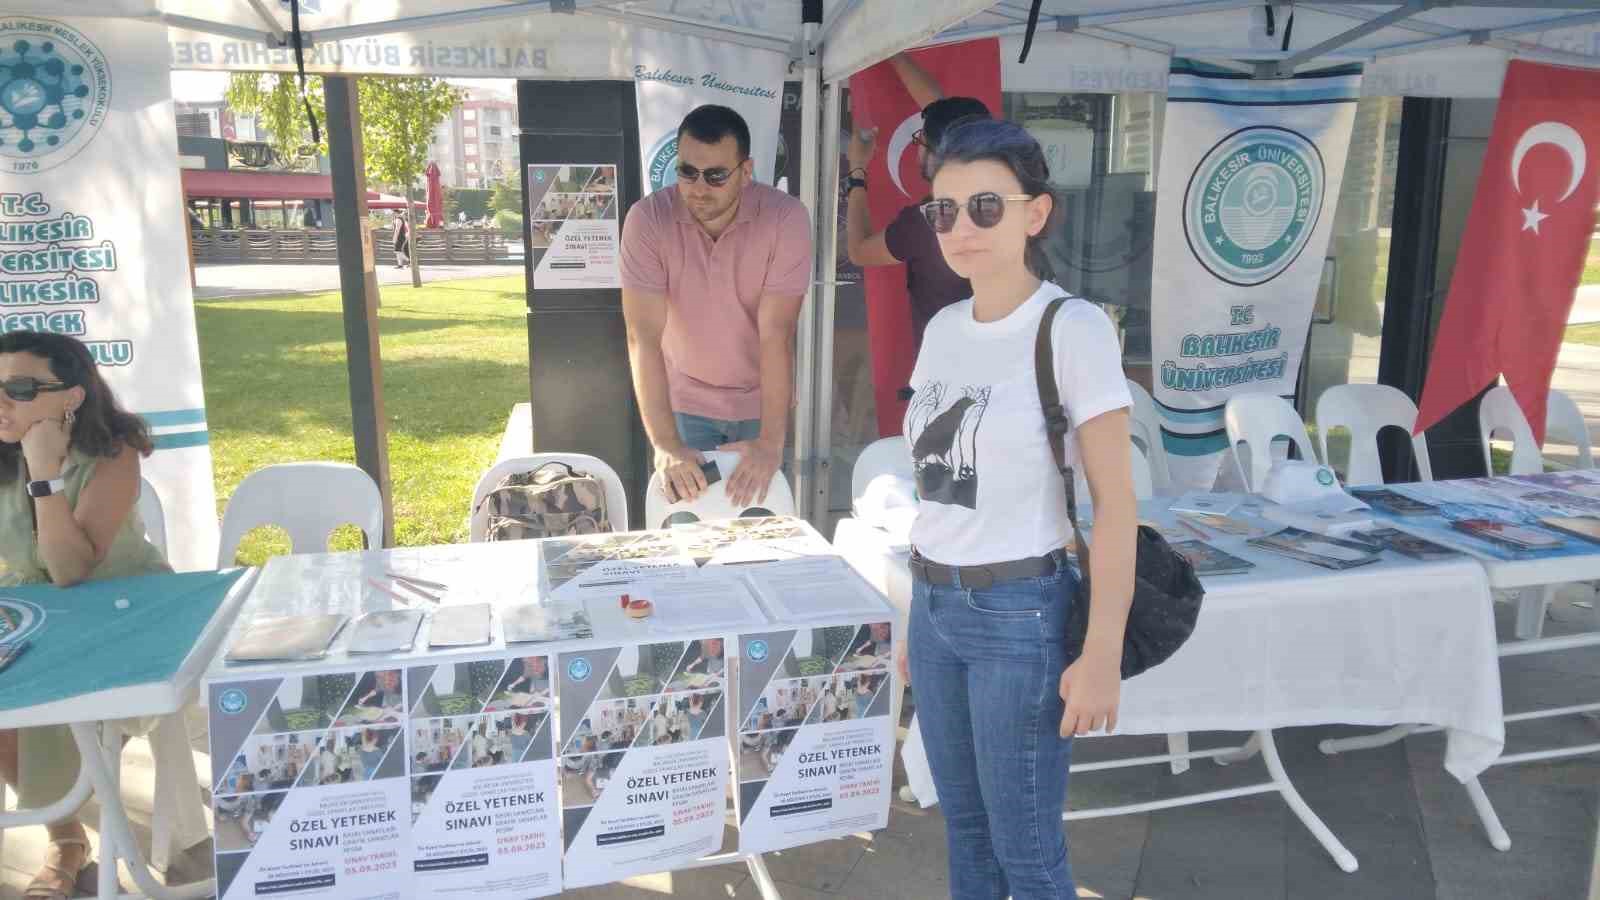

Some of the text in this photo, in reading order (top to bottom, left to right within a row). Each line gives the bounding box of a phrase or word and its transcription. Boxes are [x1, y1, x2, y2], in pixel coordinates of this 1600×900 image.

[1182, 324, 1281, 358] BALIKESİR
[1162, 353, 1288, 390] ÜNİVERSİTESİ
[798, 744, 881, 764] ÖZEL YETENEK
[626, 767, 717, 789] ÖZEL YETENEK
[798, 764, 837, 779] SINAVI
[445, 792, 544, 814] ÖZEL YETENEK
[626, 790, 669, 805] SINAVI
[290, 810, 397, 833] ÖZEL YETENEK
[445, 815, 492, 831] SINAVI
[290, 835, 339, 851] SINAVI
